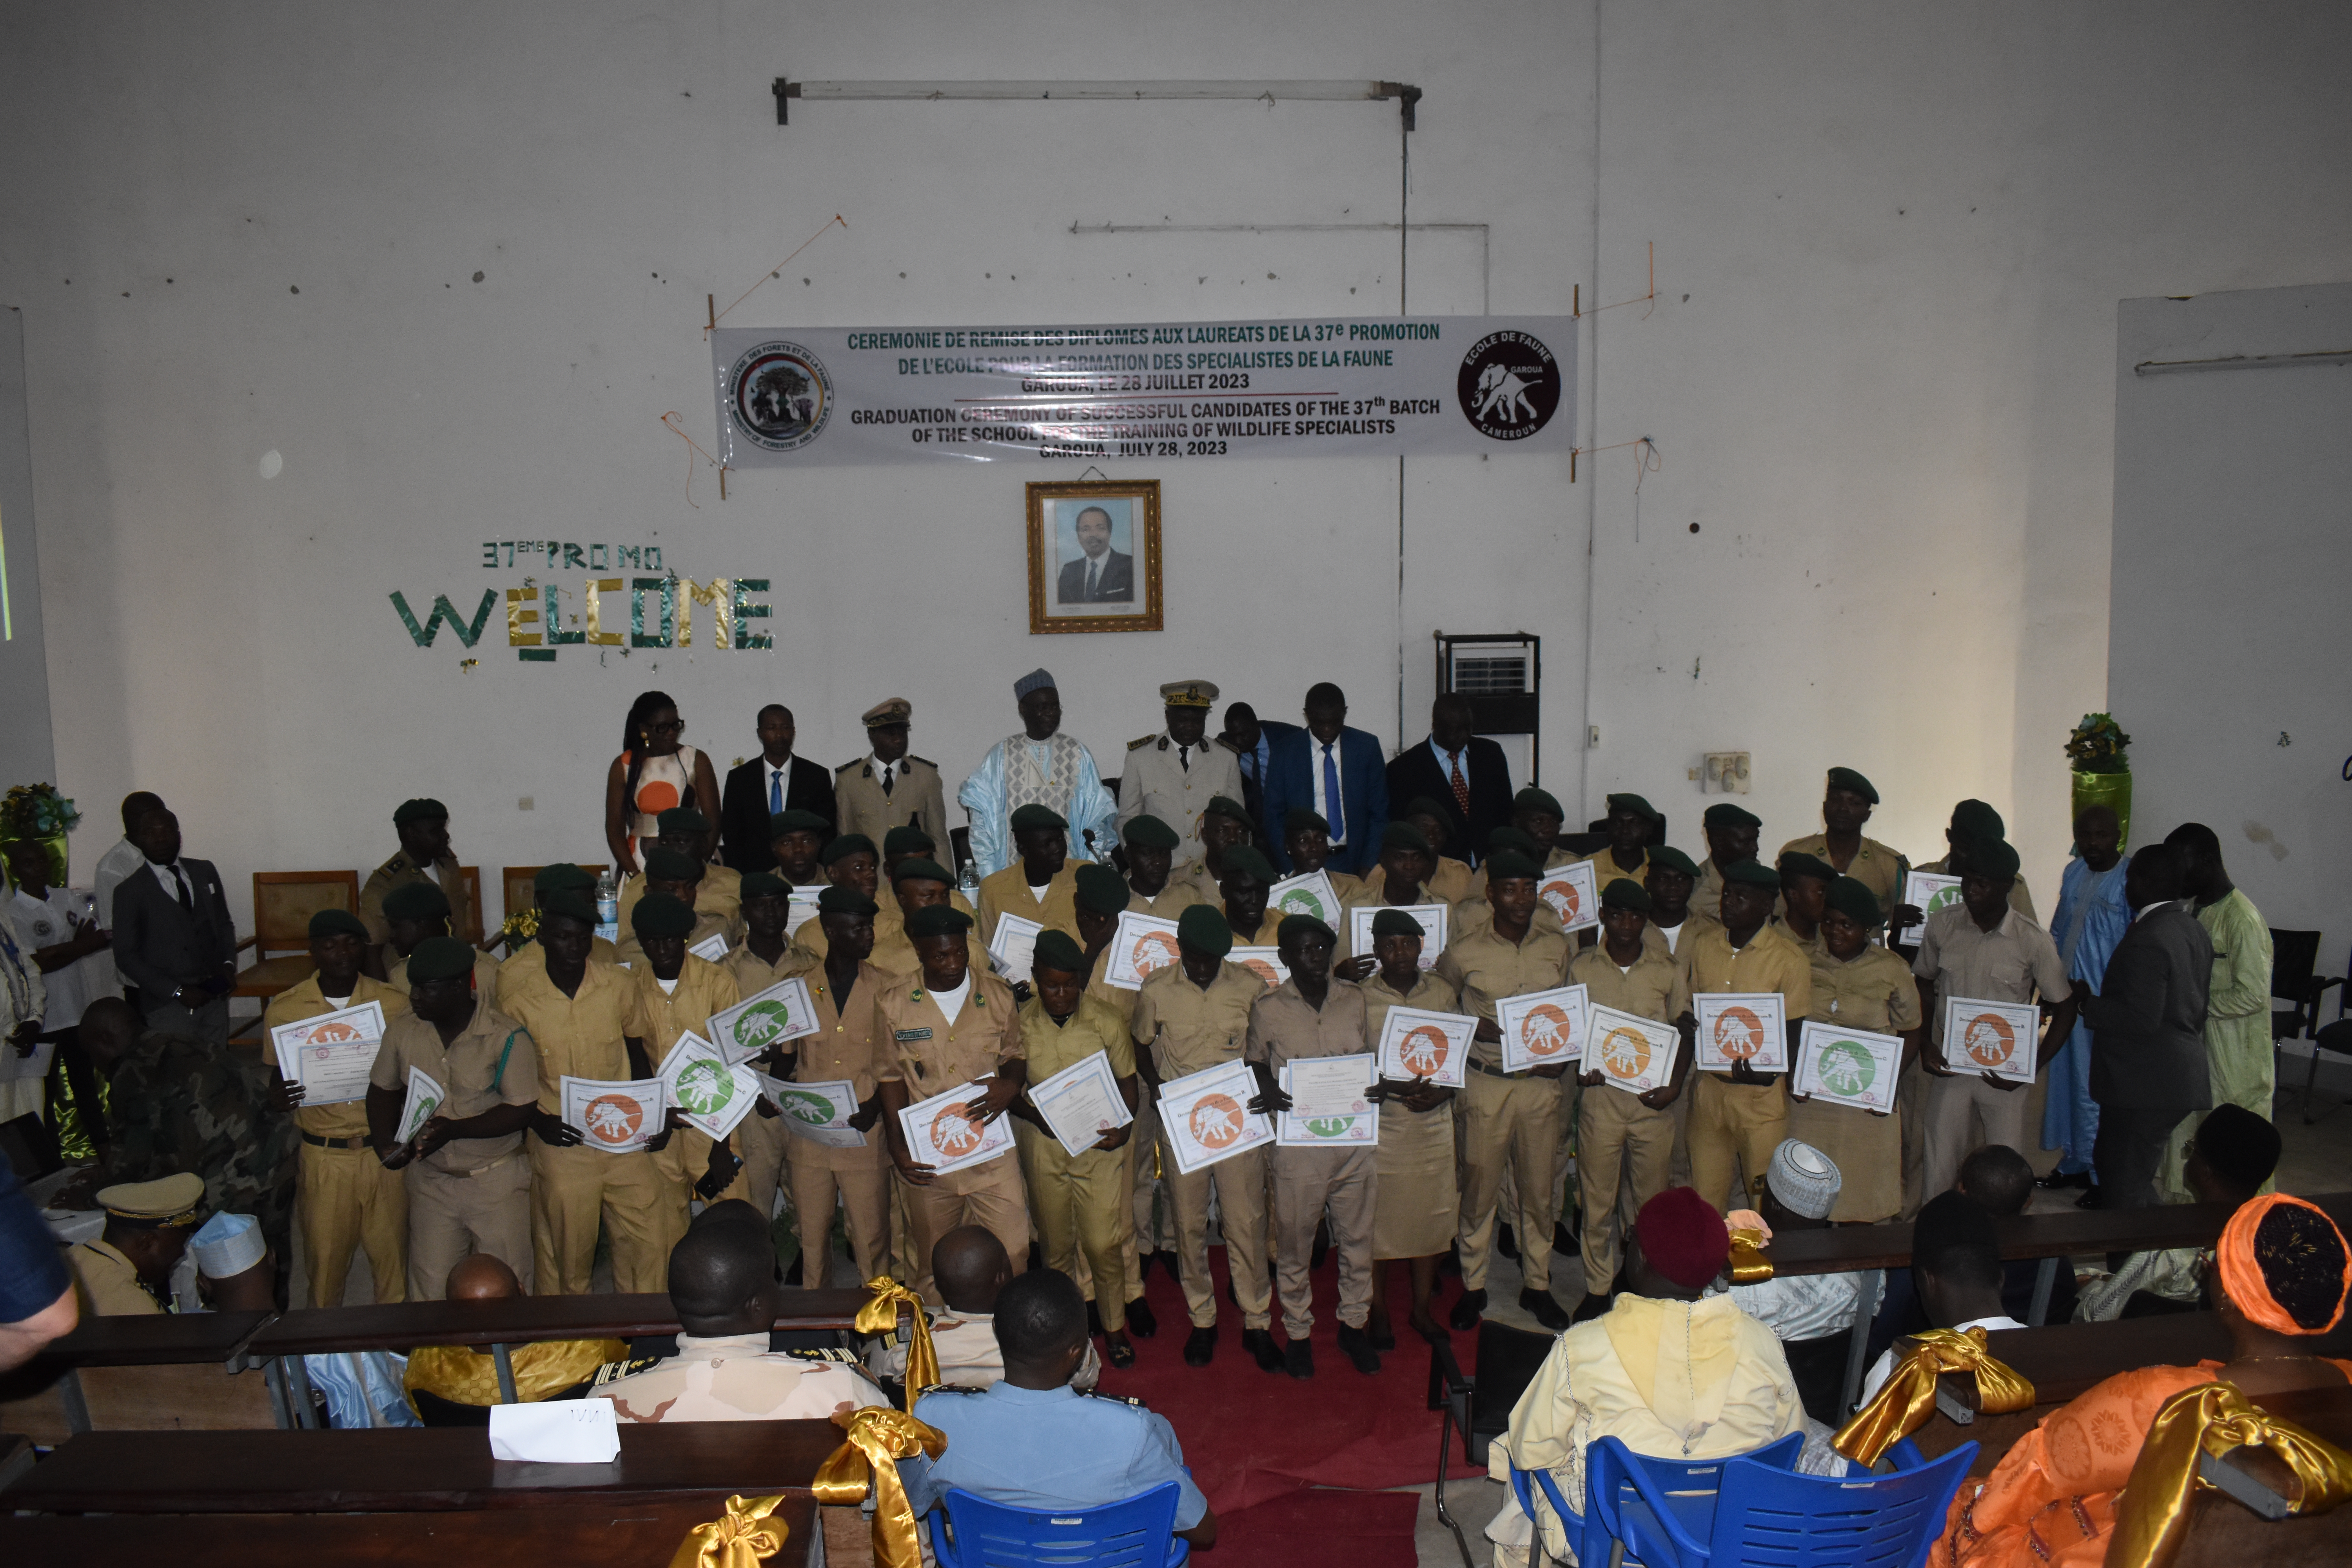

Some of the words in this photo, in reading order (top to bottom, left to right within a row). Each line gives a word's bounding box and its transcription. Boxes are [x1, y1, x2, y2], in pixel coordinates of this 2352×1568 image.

[848, 332, 941, 349] CEREMONIE
[945, 332, 966, 348] DE
[970, 331, 1030, 347] REMISE
[1034, 330, 1064, 346] DES
[1069, 328, 1149, 346] DIPLOMES
[1152, 327, 1183, 344] AUX
[1187, 326, 1264, 343] LAUREATS
[1269, 325, 1289, 342] DE
[1293, 325, 1311, 341] LA
[1315, 323, 1344, 341] 37e
[1350, 323, 1439, 340] PROMOTION
[1465, 334, 1498, 366] ECOLE
[1501, 332, 1516, 342] DE
[1519, 334, 1553, 363] FAUNE
[729, 360, 748, 395] MINISTERE
[749, 348, 762, 359] DES
[763, 345, 791, 353] FORETS
[792, 346, 801, 354] ET
[801, 352, 812, 361] DE
[810, 359, 819, 367] LA
[817, 366, 831, 392] FAUNE
[898, 358, 919, 375] DE
[923, 356, 984, 374] L'ECOLE
[1059, 354, 1148, 371] FORMATION
[1153, 353, 1183, 370] DES
[1187, 352, 1293, 370] SPECIALISTES
[1298, 351, 1318, 368] DE
[1321, 351, 1340, 367] LA
[1343, 350, 1393, 367] FAUNE
[1099, 375, 1117, 390] LE
[1121, 375, 1142, 390] 28
[1145, 374, 1205, 390] JUILLET
[1209, 373, 1250, 389] 2023
[851, 408, 956, 424] GRADUATION
[960, 407, 1050, 423] CEREMONY
[1056, 406, 1077, 421] OF
[1081, 404, 1188, 420] SUCCESSFUL
[1191, 402, 1291, 418] CANDIDATES
[1296, 401, 1317, 416] OF
[1319, 401, 1350, 416] THE
[1353, 396, 1385, 415] 37th
[1389, 399, 1440, 415] BATCH
[763, 440, 798, 448] FORESTRY
[799, 434, 812, 444] AND
[812, 406, 829, 434] WILDLIFE
[912, 428, 933, 443] OF
[936, 427, 967, 442] THE
[971, 426, 1038, 441] SCHOOL
[1078, 425, 1109, 439] THE
[1113, 423, 1187, 439] TRAINING
[1192, 422, 1213, 437] OF
[1216, 421, 1291, 436] WILDLIFE
[1295, 419, 1395, 435] SPECIALISTS
[1481, 423, 1537, 439] CAMEROUN
[1040, 443, 1111, 459] GAROUA,
[1118, 442, 1154, 456] JULY
[1157, 441, 1183, 458] 28,
[1187, 441, 1227, 455] 2023
[389, 578, 773, 649] WELCOME
